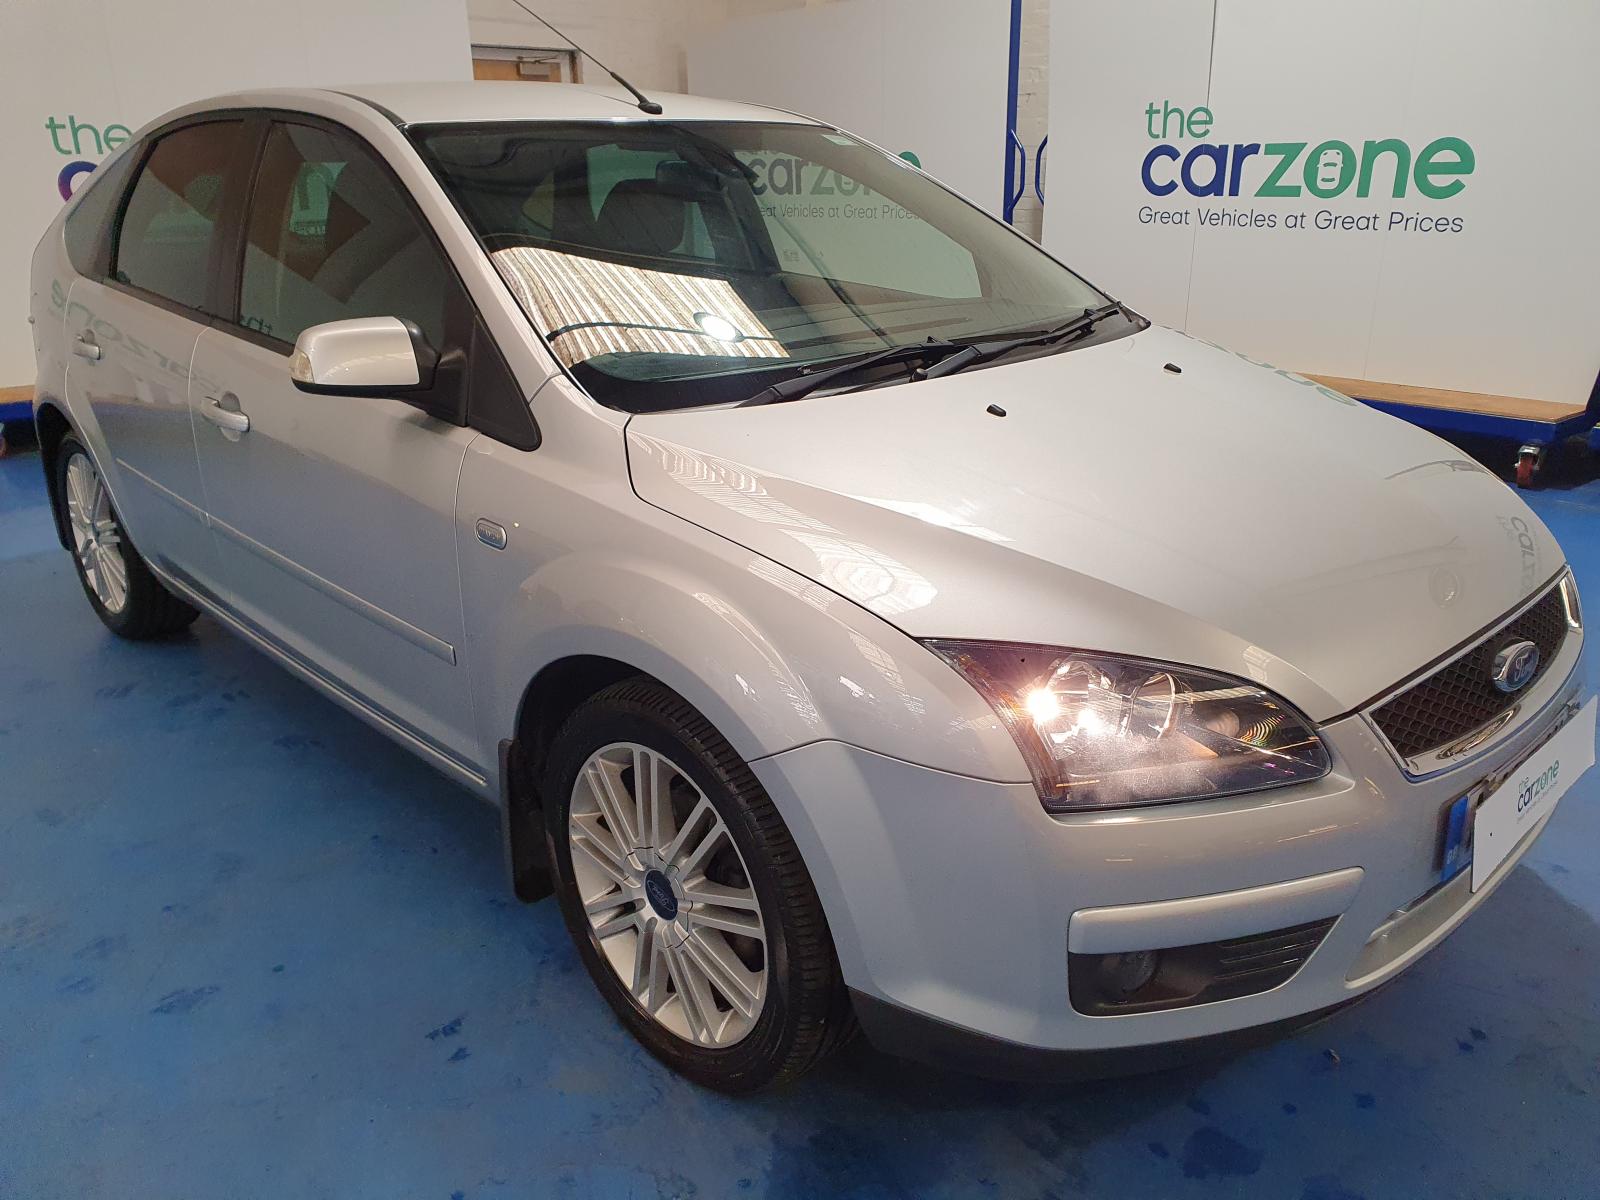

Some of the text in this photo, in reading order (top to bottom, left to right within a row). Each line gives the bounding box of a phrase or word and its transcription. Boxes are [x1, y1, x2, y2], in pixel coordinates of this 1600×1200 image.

[45, 115, 132, 155] the
[1145, 100, 1213, 139] the
[1141, 137, 1475, 199] carzone
[781, 204, 824, 219] Vehicles
[828, 206, 840, 219] at
[844, 203, 878, 219] Great
[1138, 206, 1464, 233] Great Vehicles at Great Prices
[1517, 760, 1559, 813] carzone
